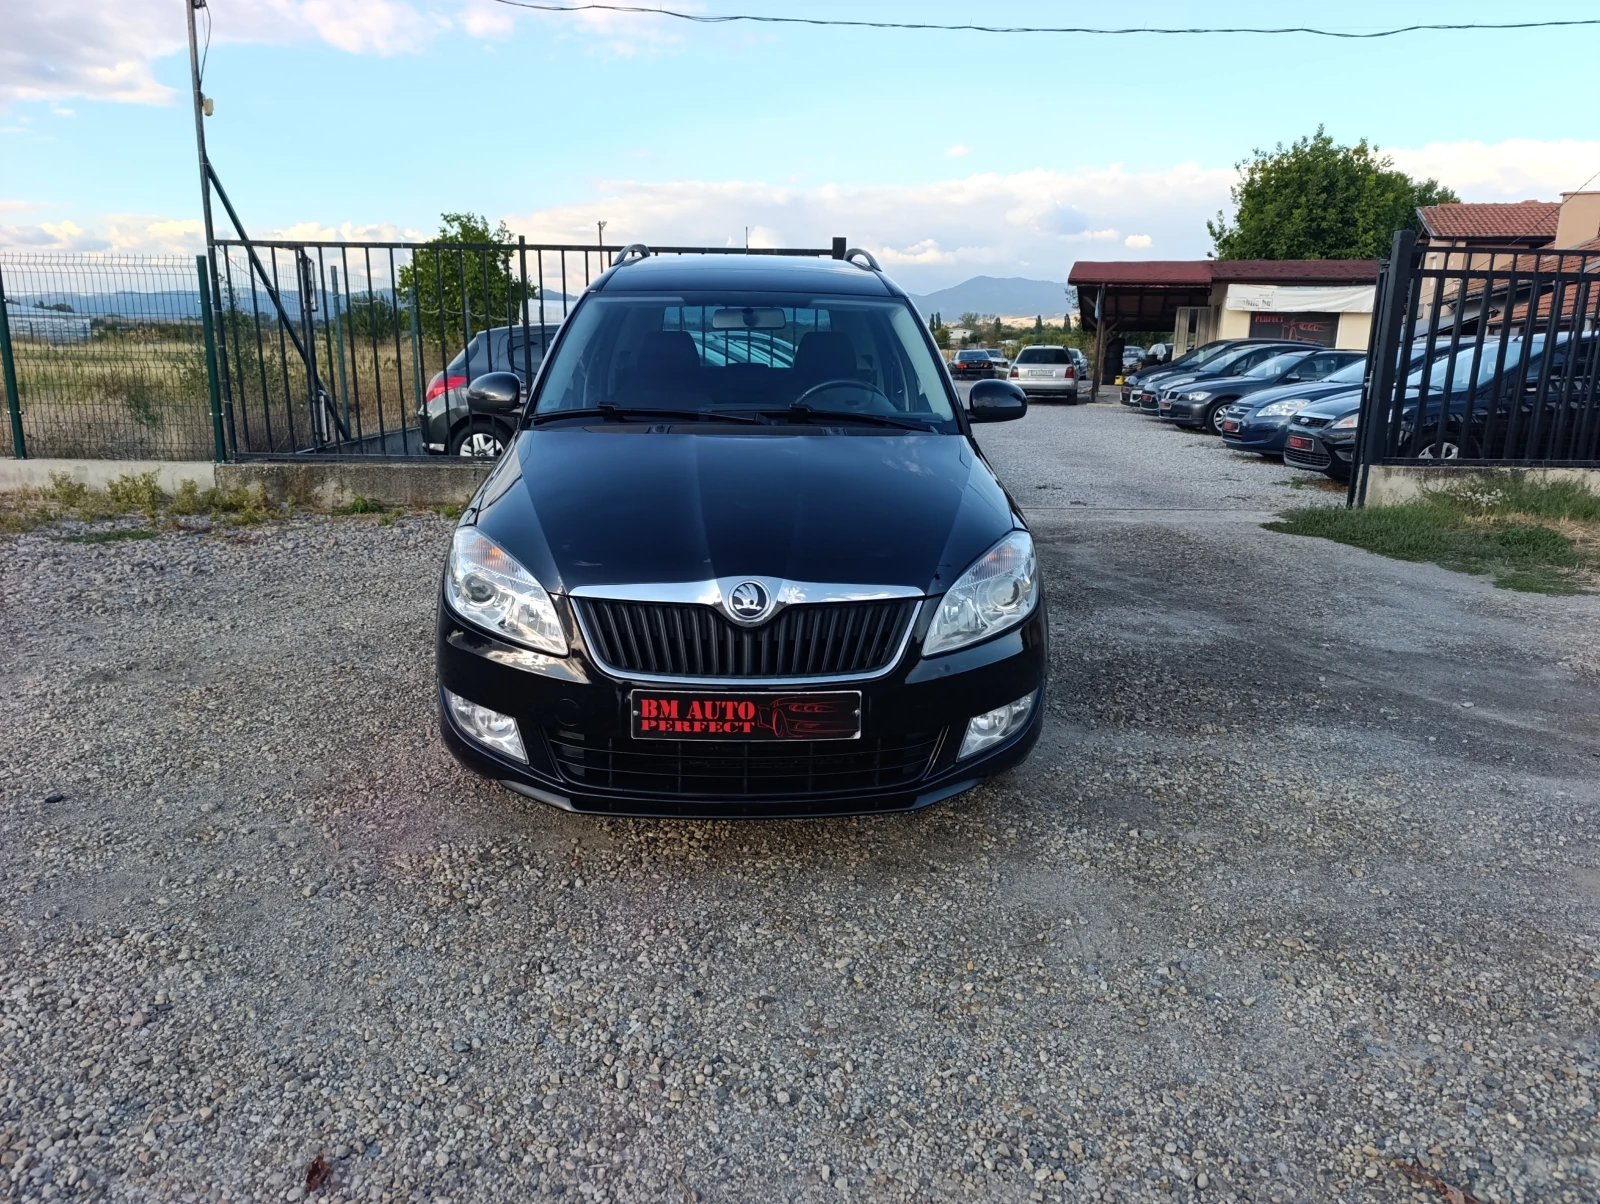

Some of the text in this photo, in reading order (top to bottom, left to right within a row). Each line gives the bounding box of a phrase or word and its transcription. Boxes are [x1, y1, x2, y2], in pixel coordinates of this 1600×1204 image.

[1255, 315, 1284, 323] PERFECT
[641, 699, 755, 720] BM AUTO
[641, 719, 755, 732] PERFECT
